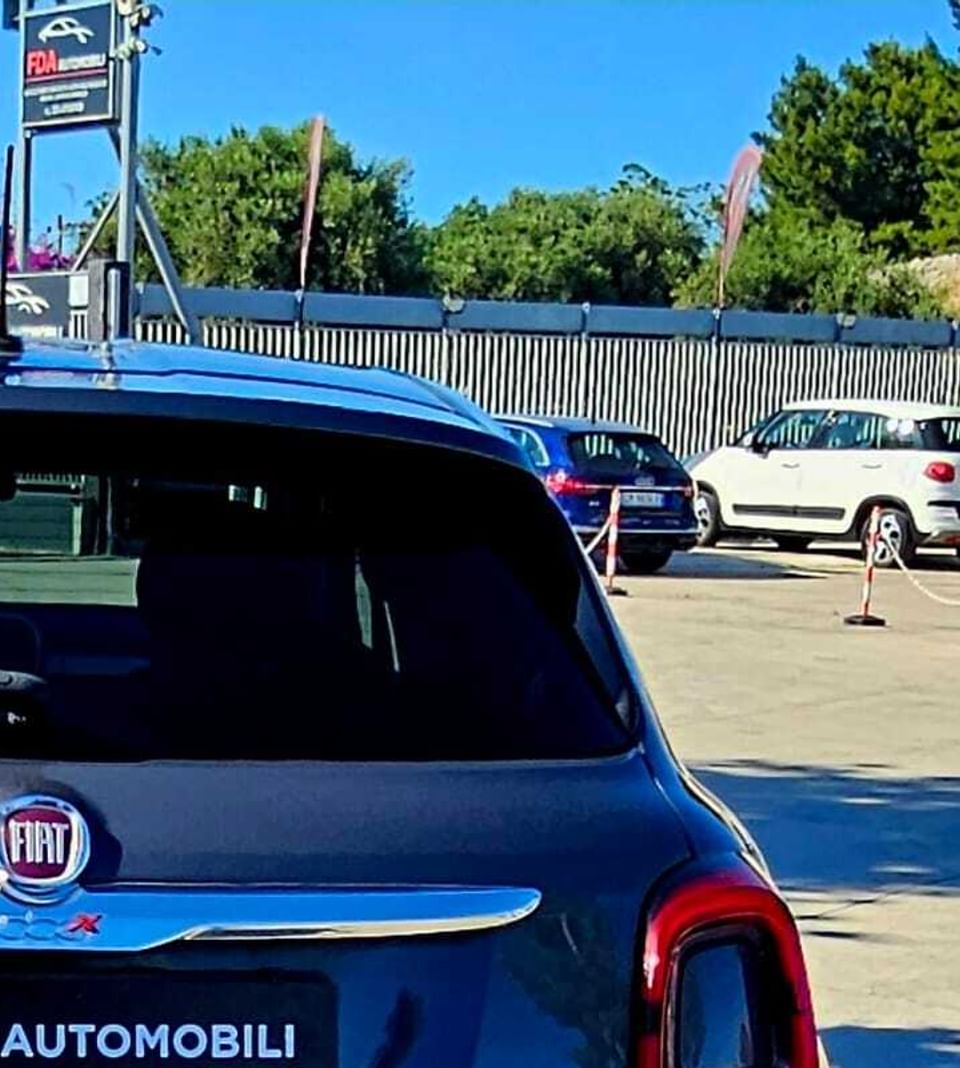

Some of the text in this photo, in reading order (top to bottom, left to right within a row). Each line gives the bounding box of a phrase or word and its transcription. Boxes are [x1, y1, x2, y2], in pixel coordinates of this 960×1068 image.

[27, 49, 58, 75] FDA
[8, 819, 69, 865] FIAT
[0, 1023, 295, 1058] AUTOMOBILI
